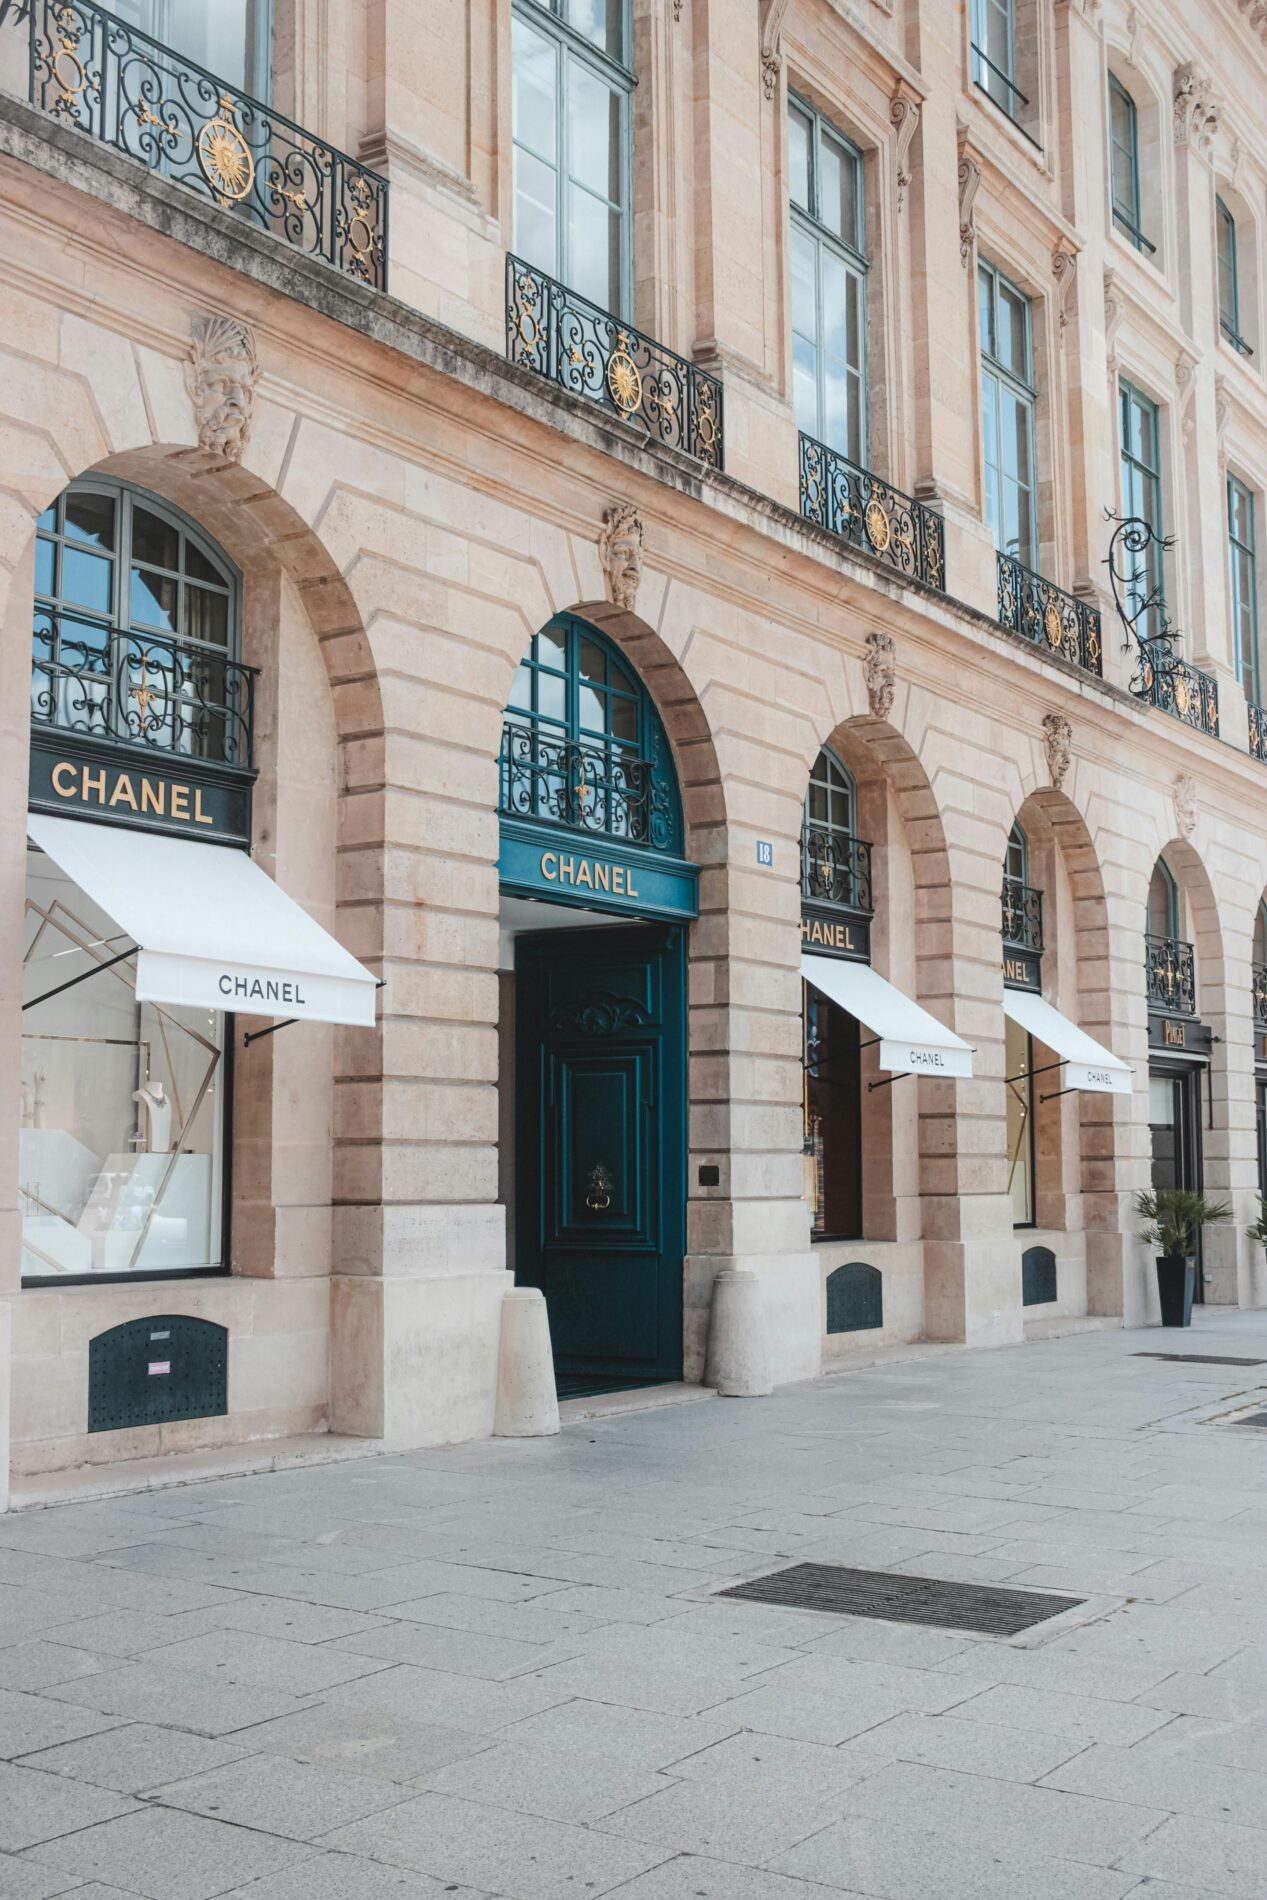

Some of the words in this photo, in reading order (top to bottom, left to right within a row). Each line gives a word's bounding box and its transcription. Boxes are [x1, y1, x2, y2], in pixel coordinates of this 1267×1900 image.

[51, 762, 213, 824] CHANEL
[759, 844, 770, 863] 18
[541, 852, 638, 897] CHANEL
[800, 919, 854, 950] HANEL
[219, 974, 305, 1005] CHANEL
[910, 1051, 944, 1067] CHANEL
[1087, 1072, 1112, 1085] CHANEL
